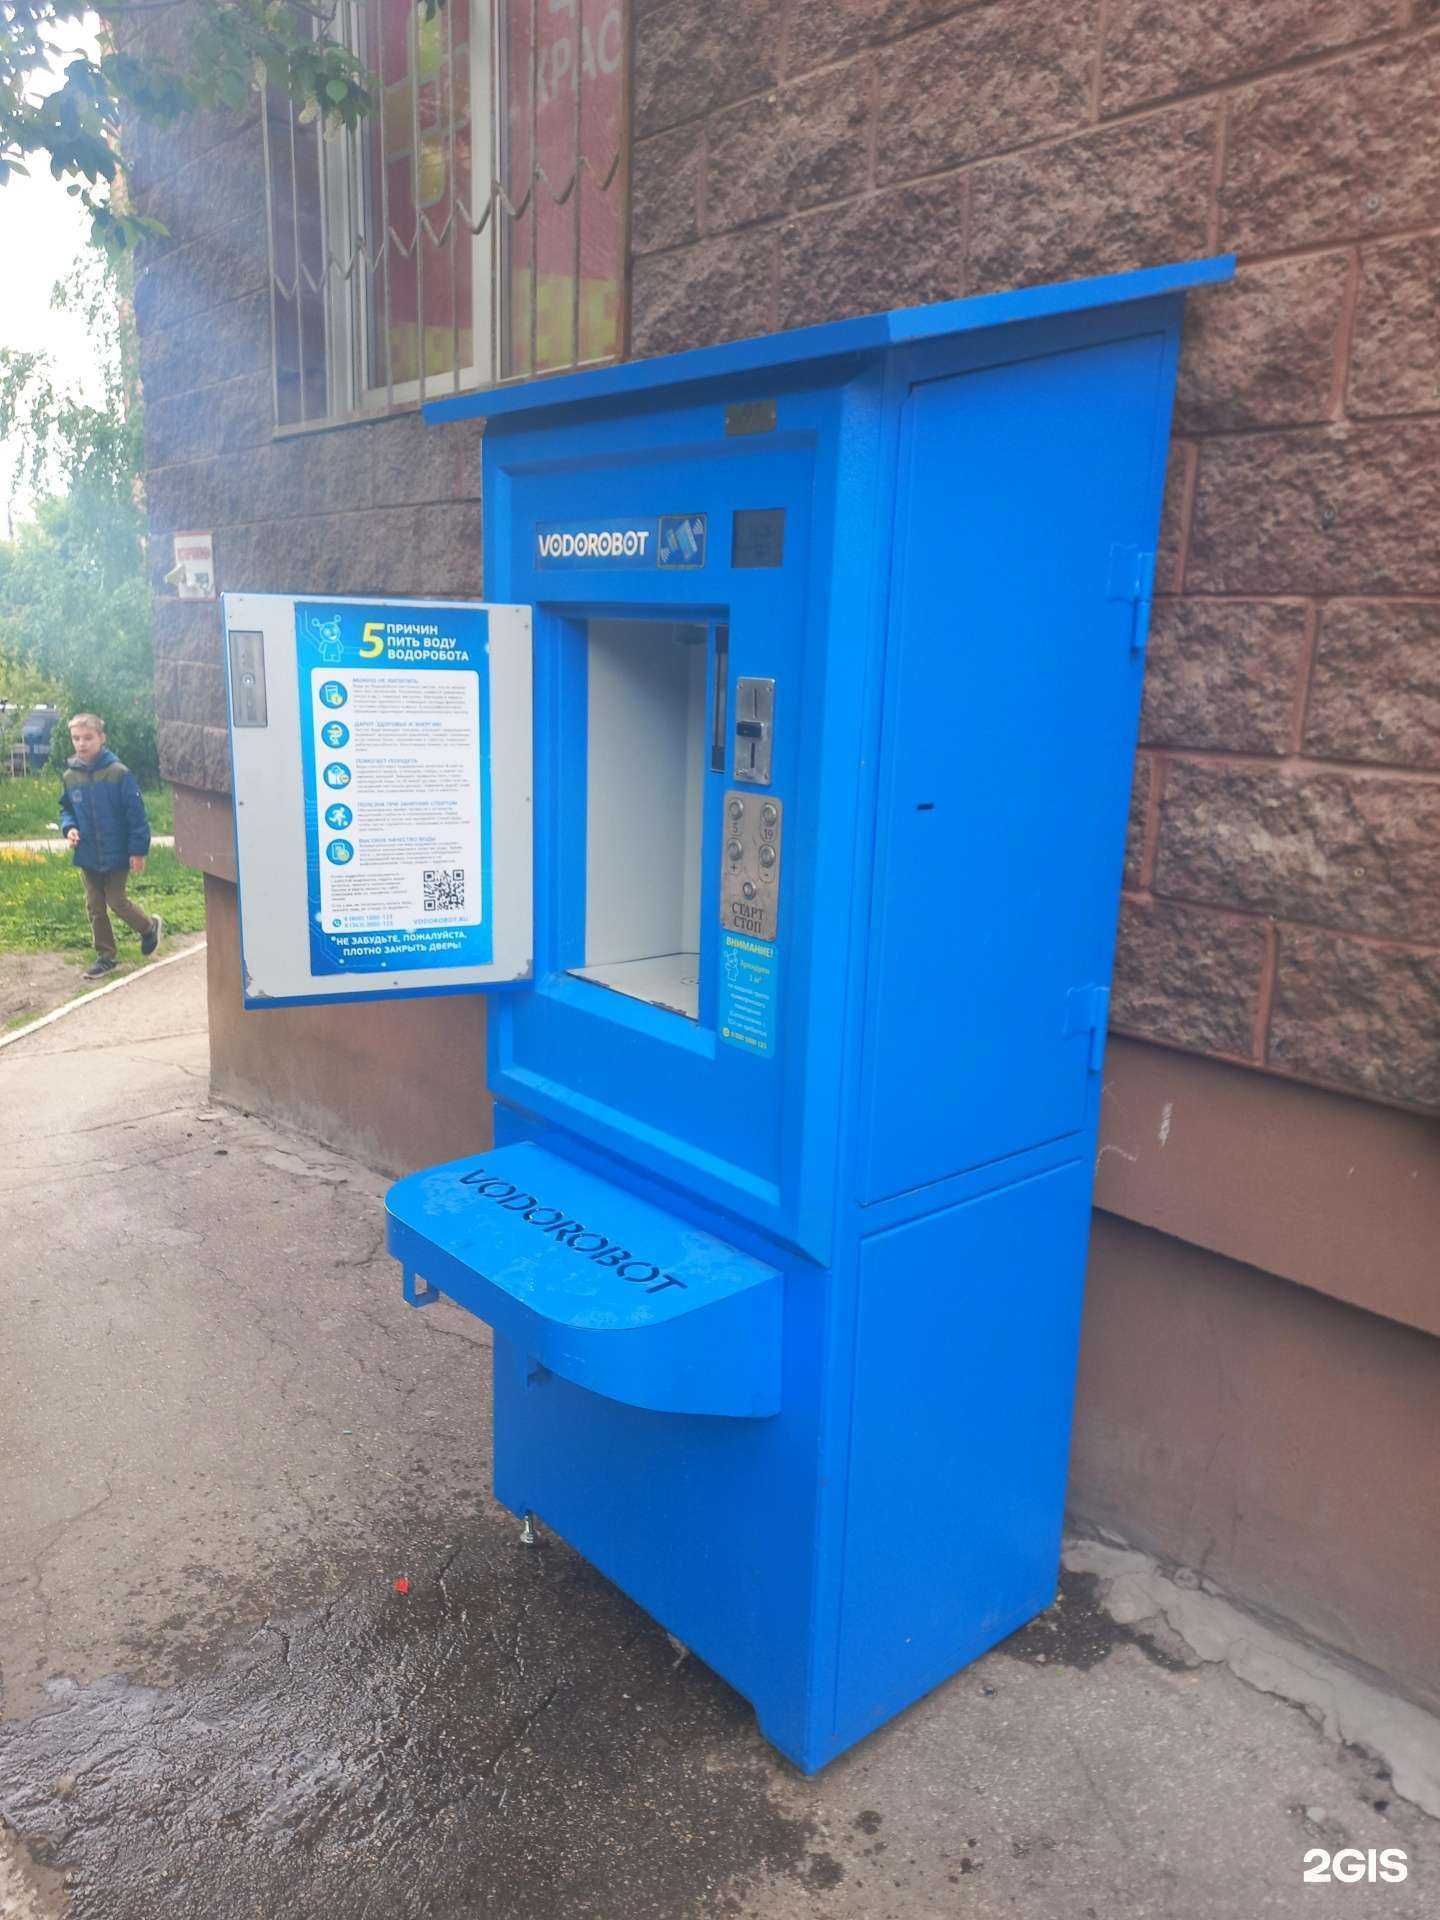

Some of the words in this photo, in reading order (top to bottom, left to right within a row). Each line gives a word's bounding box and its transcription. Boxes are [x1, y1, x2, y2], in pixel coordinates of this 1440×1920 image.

[538, 531, 649, 557] VODOROBOT
[360, 622, 385, 658] 5
[386, 623, 438, 635] ПРИЧИН
[387, 636, 420, 647] ПИТЬ
[423, 638, 457, 650] ВОДУ
[388, 649, 469, 661] ВОДОРОБОТА
[731, 902, 765, 920] СТАРТ
[734, 917, 761, 934] СТОП
[336, 937, 349, 946] НЕ
[343, 947, 382, 956] ПЛОТНО
[384, 944, 426, 954] ЗАКРЫТЬ
[459, 1169, 688, 1294] VODOROBOT
